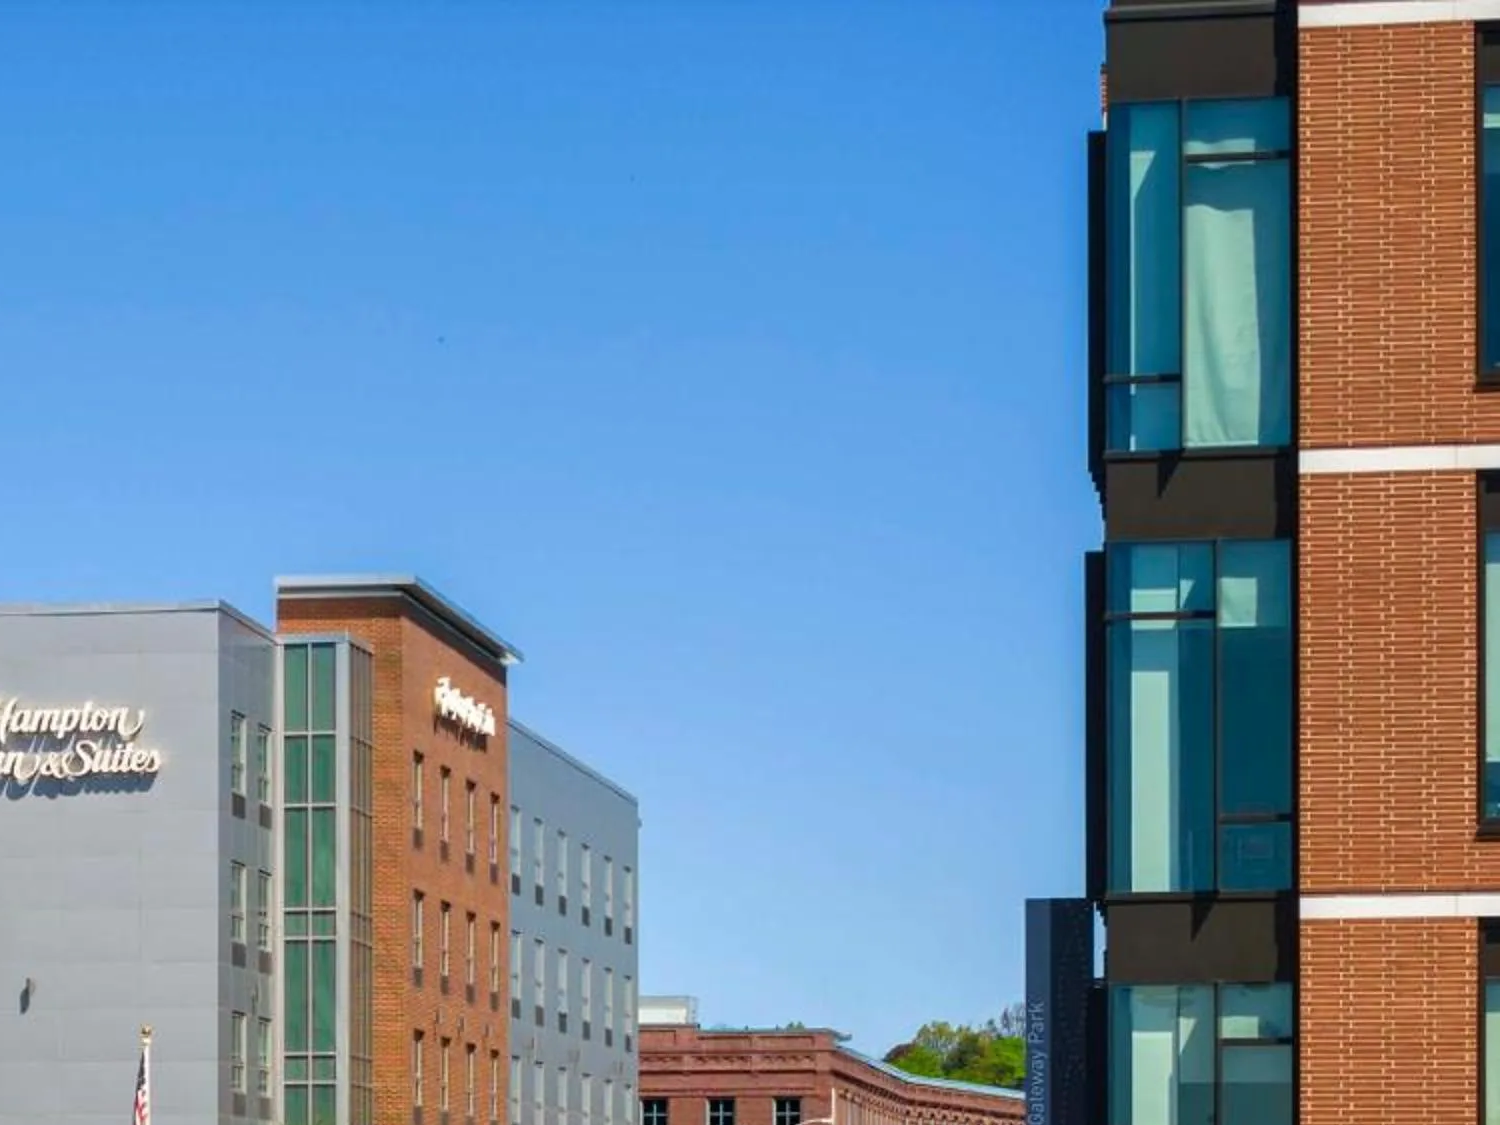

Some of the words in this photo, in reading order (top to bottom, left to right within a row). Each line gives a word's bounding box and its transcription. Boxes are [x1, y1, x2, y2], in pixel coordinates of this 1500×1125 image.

[40, 751, 63, 778] &
[62, 740, 162, 777] Suites
[1028, 1001, 1045, 1043] Park
[1028, 1051, 1047, 1125] Gateway
